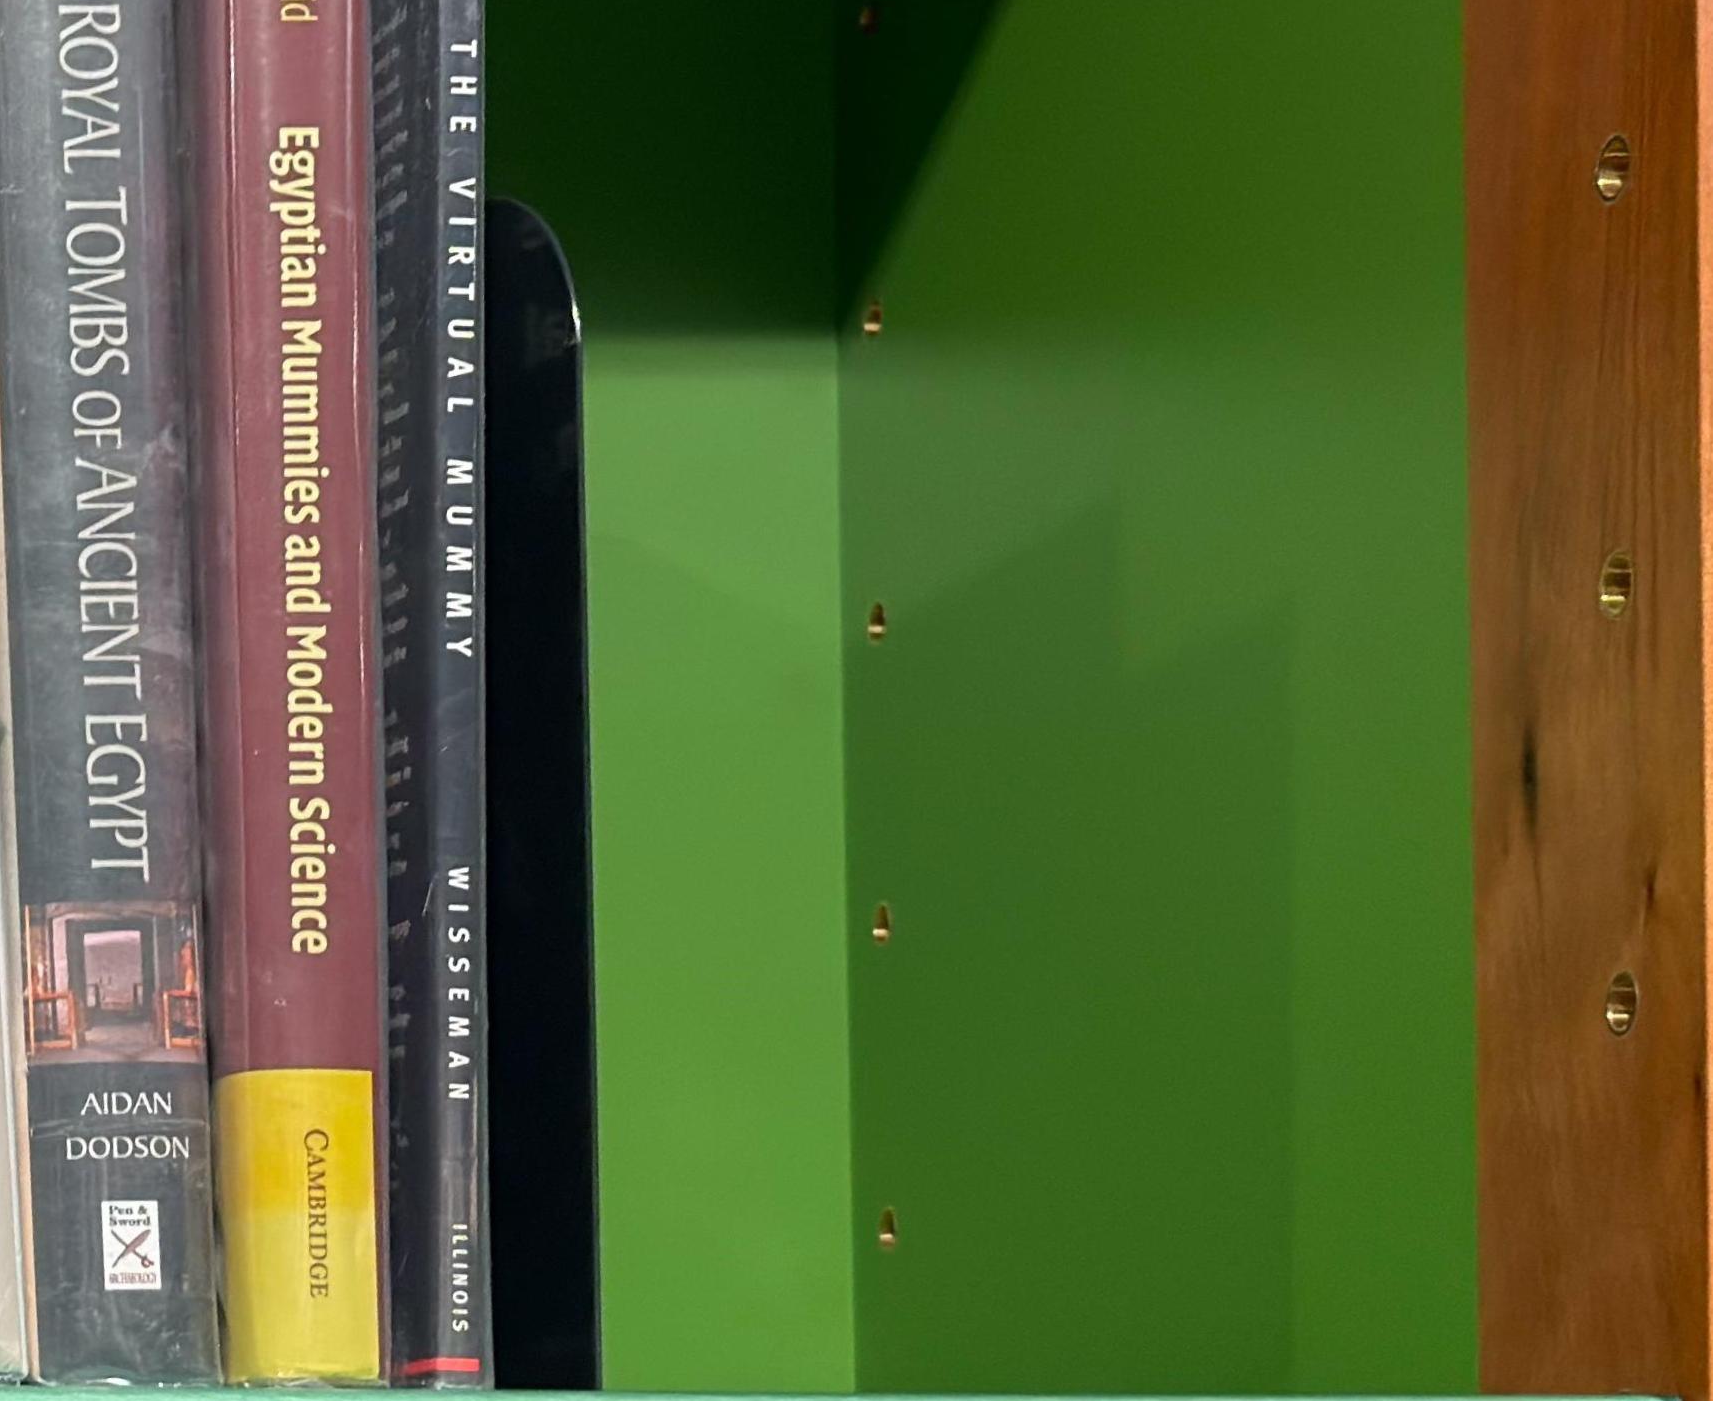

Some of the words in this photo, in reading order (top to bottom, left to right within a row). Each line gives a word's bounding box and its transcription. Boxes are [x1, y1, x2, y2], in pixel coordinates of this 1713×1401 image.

[58, 3, 122, 176] ROYAL
[63, 186, 130, 378] TOMBS
[267, 125, 327, 311] Egyptian
[71, 388, 122, 451] OF
[280, 317, 330, 525] Mummies
[75, 456, 142, 700] ANCIENT
[284, 534, 331, 613] and
[286, 623, 333, 787] Modern
[84, 712, 150, 884] EGYPT
[289, 796, 335, 957] Science
[447, 866, 469, 1100] WISSEMAN
[65, 1136, 190, 1160] DODSON
[80, 1091, 172, 1116] AIDAN
[451, 1223, 468, 1333] ILLINOIS
